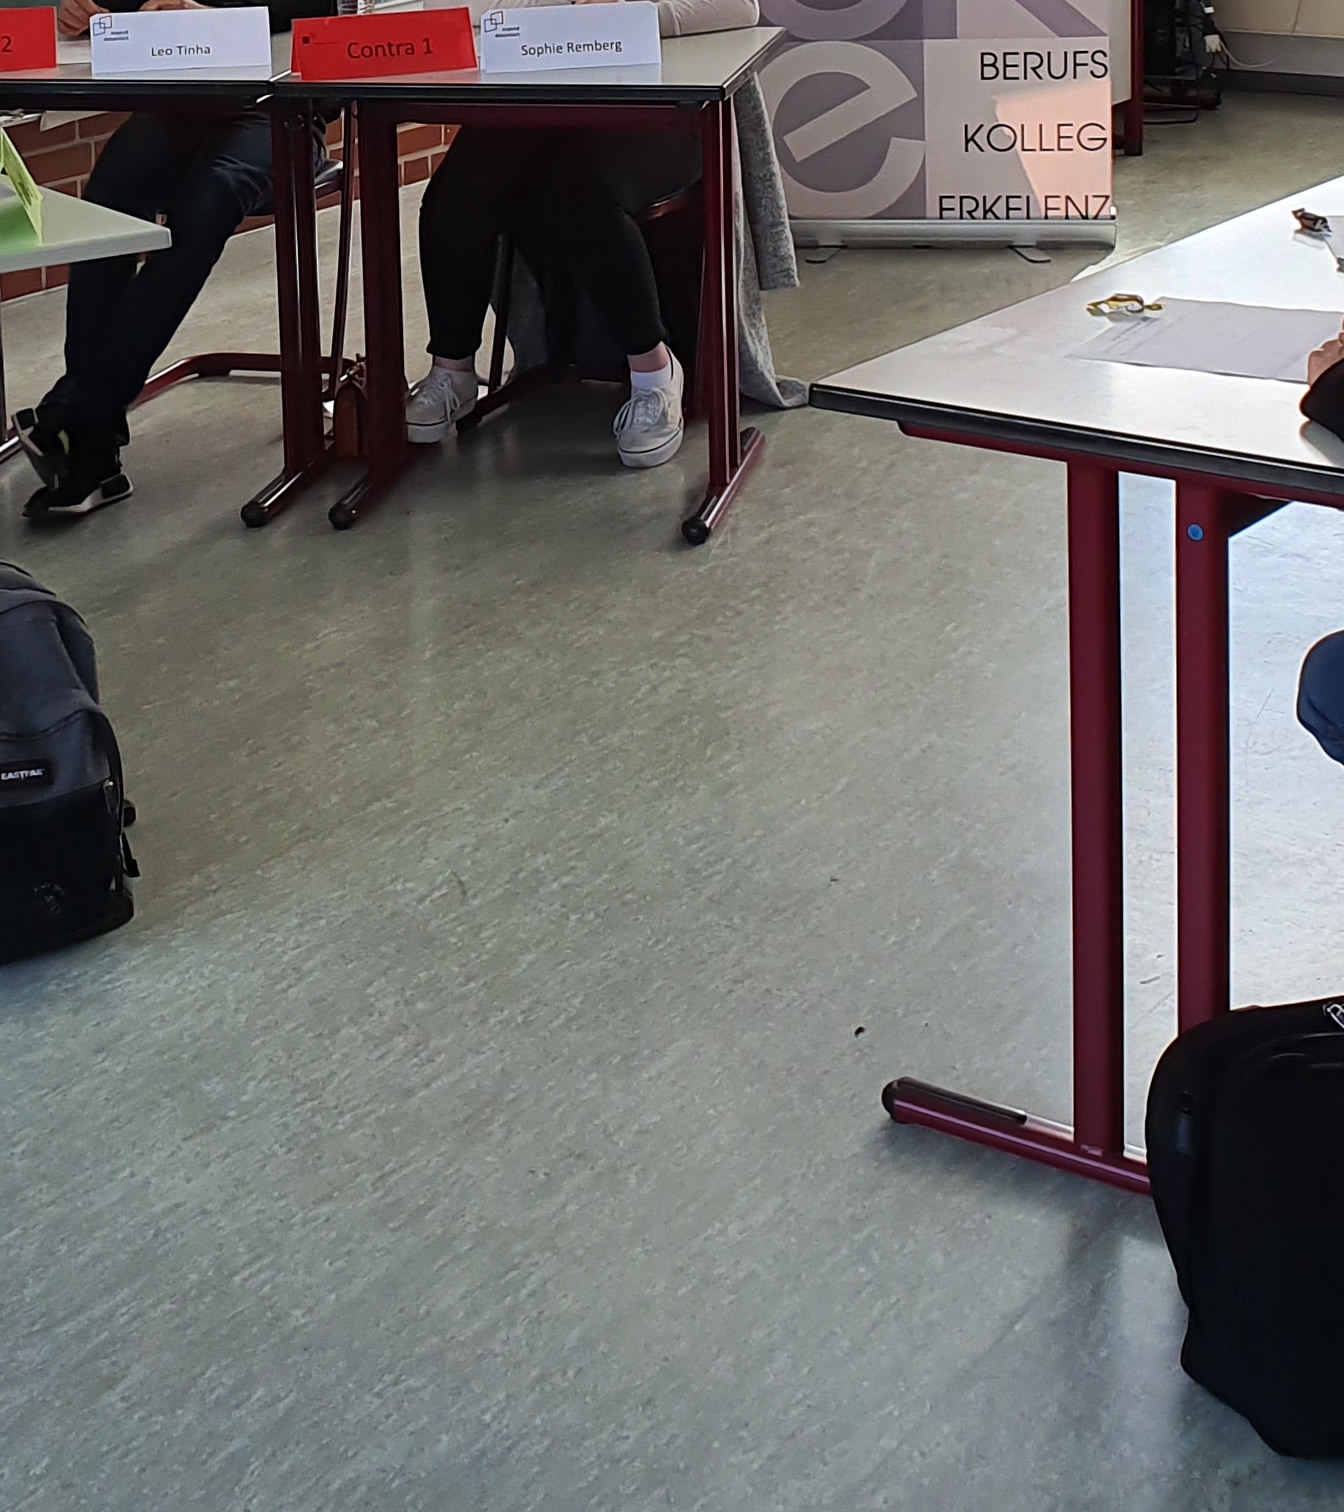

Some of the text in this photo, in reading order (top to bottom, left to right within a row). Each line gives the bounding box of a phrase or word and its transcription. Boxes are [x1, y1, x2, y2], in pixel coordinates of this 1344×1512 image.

[0, 35, 13, 53] 2
[150, 44, 211, 57] Leo Tinha
[347, 37, 434, 59] Contra 1
[521, 39, 623, 57] Sophie Remberg
[978, 50, 1109, 82] BERUFS
[963, 122, 1109, 153] KOLLEG
